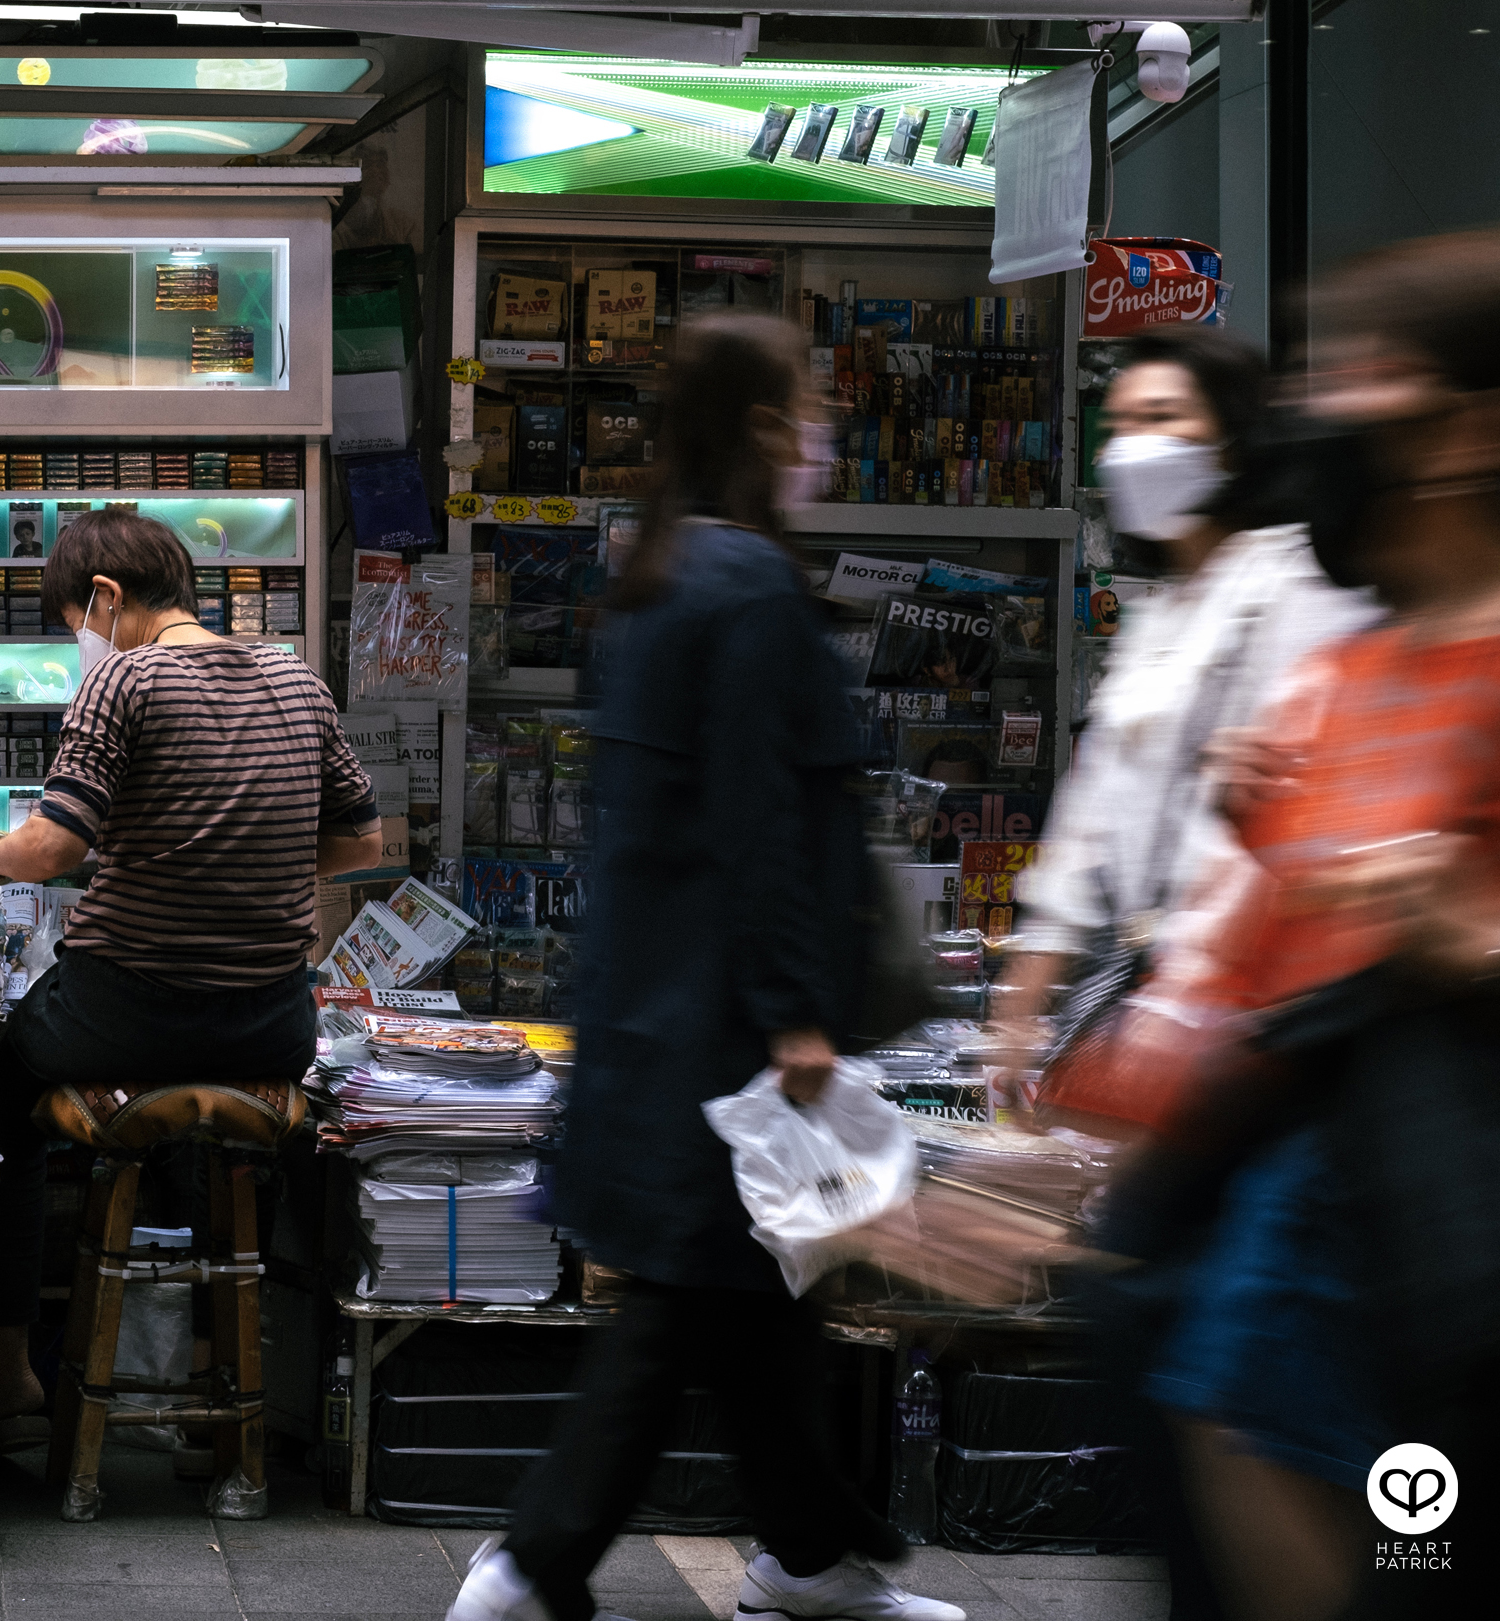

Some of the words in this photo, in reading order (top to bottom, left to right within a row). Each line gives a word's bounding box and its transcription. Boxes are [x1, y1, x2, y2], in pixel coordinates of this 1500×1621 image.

[1132, 266, 1147, 277] 120
[598, 296, 647, 315] RAW
[1087, 276, 1208, 324] Smoking
[505, 300, 552, 317] RAW
[1144, 306, 1180, 324] FILTERS
[496, 347, 526, 356] ZIG-ZAG
[601, 416, 639, 430] OCB
[955, 422, 964, 452] OCB
[527, 440, 557, 451] OCB
[510, 501, 525, 516] 83
[362, 567, 408, 578] Economist
[842, 565, 901, 581] MOTOR
[345, 733, 374, 748] WALL
[930, 1106, 987, 1122] RINGS
[901, 1404, 940, 1429] vita
